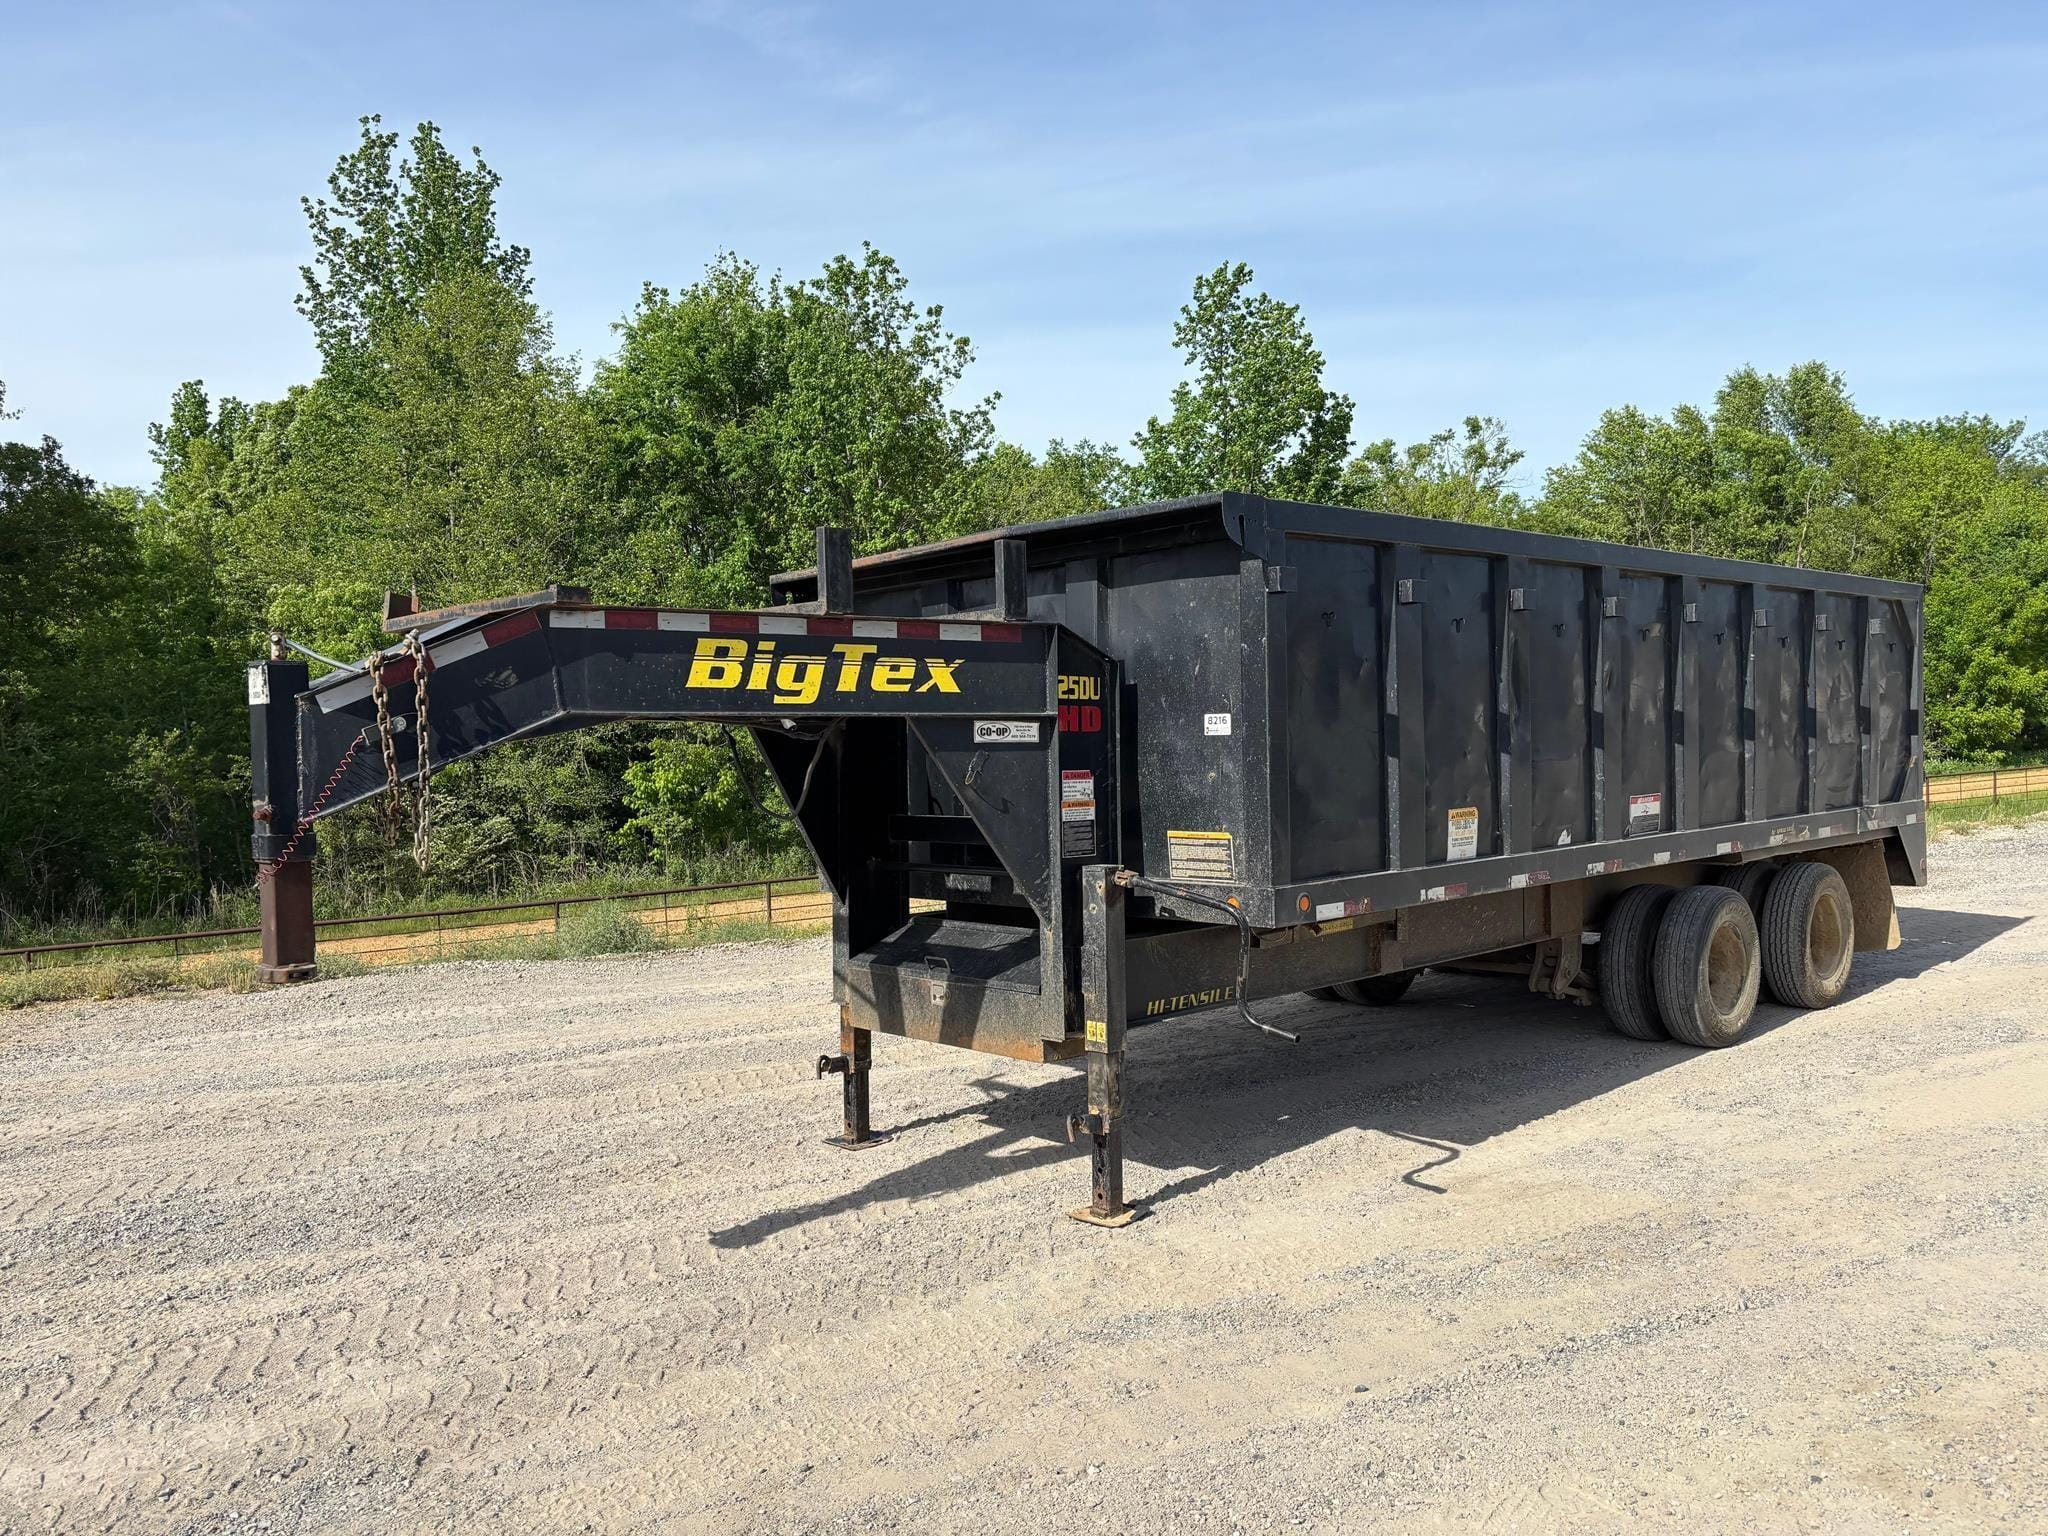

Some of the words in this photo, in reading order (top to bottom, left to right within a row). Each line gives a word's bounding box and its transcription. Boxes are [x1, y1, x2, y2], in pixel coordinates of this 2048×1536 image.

[685, 638, 965, 704] BigTex
[1058, 705, 1101, 732] HD
[1208, 716, 1227, 725] 8216
[980, 727, 1008, 737] CO-OP
[1455, 810, 1476, 818] WARNING
[1147, 986, 1234, 1015] HI-TENSILE
